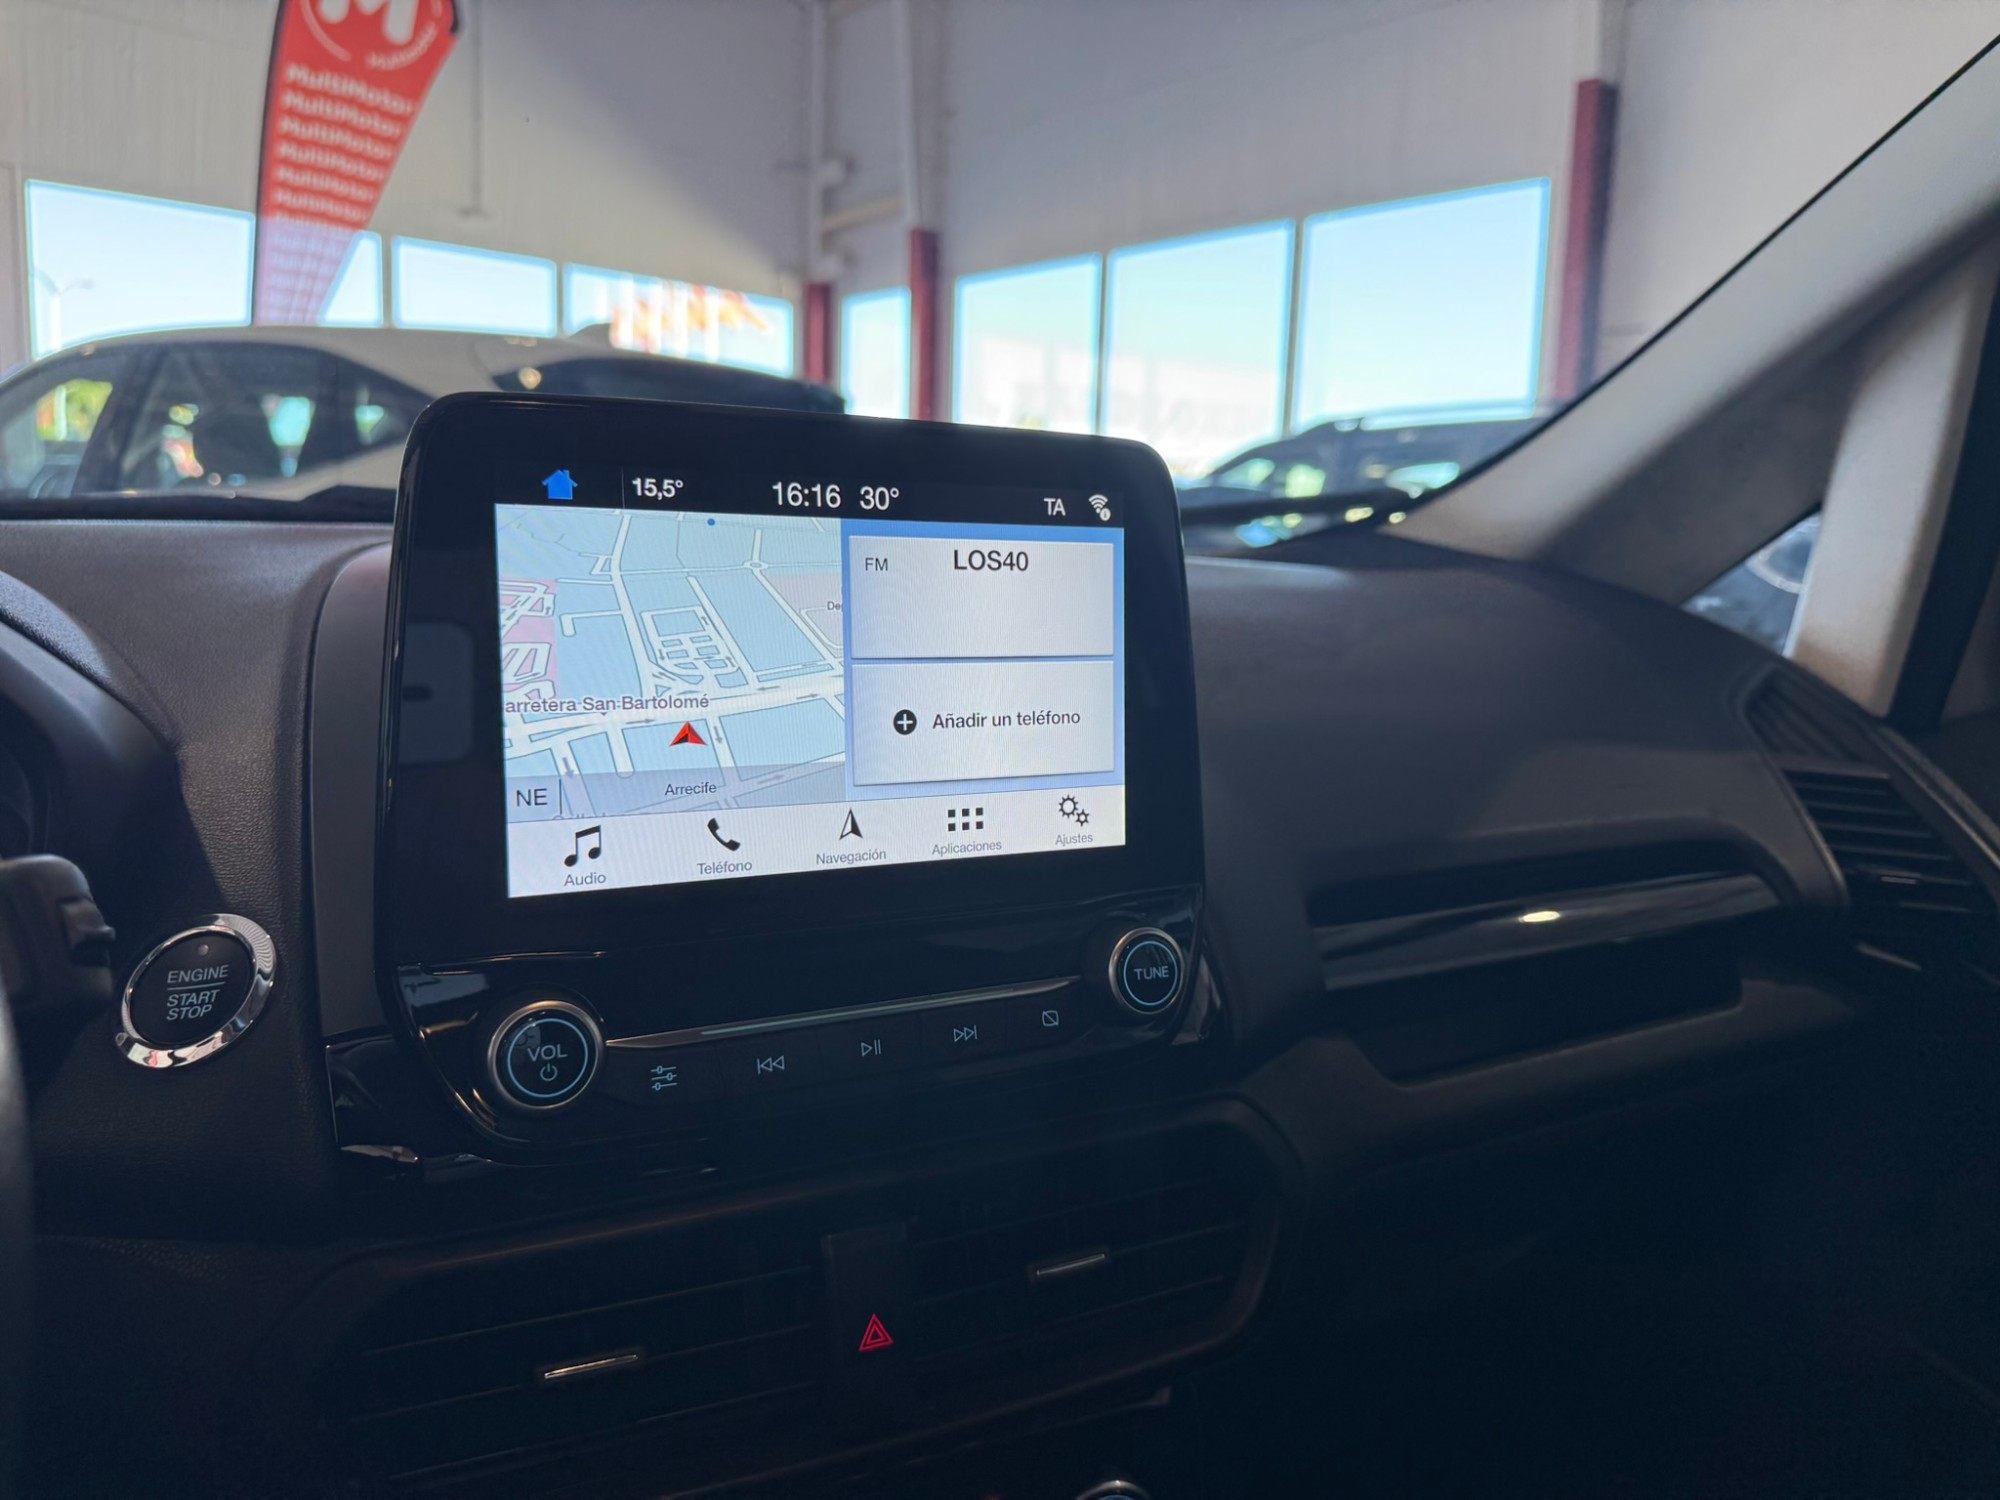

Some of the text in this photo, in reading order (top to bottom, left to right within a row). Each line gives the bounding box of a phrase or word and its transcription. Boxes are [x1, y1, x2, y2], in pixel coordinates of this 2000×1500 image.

[632, 477, 684, 500] 15,5°
[772, 481, 842, 509] 16:16
[859, 486, 900, 511] 30°
[1043, 497, 1066, 517] TA
[864, 557, 889, 572] FM
[953, 549, 1029, 572] LOS40
[827, 600, 843, 612] De
[582, 696, 617, 712] San
[621, 692, 710, 711] Bartolomé
[932, 709, 1081, 730] Añadir un teléfono
[515, 787, 548, 808] NE
[664, 781, 717, 796] Arrecife
[931, 838, 1003, 857] Aplicaciones
[1054, 832, 1094, 847] Ajustes
[815, 847, 887, 867] Navegación
[696, 859, 753, 876] Teléfono
[563, 871, 607, 888] Audio
[166, 964, 230, 985] ENGINE
[1133, 965, 1170, 981] TUNE
[166, 988, 221, 1008] START
[166, 1004, 213, 1021] STOP
[527, 1043, 569, 1062] VOL
